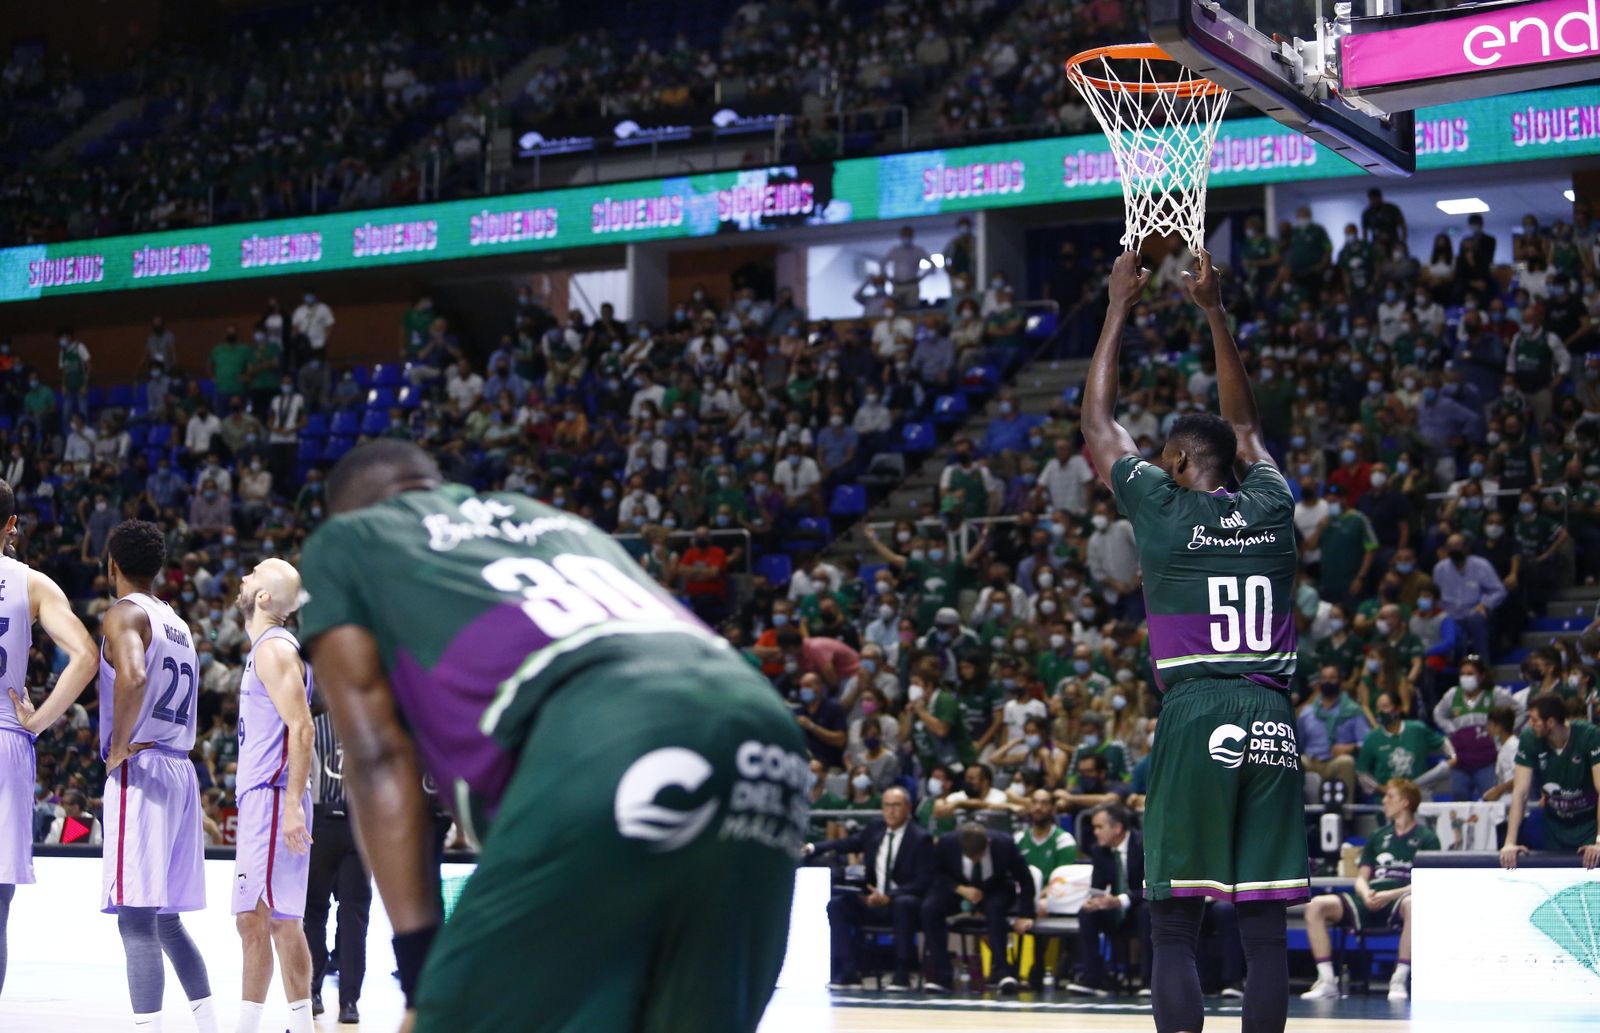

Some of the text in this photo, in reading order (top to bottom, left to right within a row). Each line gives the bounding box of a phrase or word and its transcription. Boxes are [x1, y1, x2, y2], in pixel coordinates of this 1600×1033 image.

[481, 553, 676, 638] 30
[1208, 575, 1274, 652] 50
[151, 656, 194, 726] 22
[1247, 751, 1299, 771] MÁLAGA
[1249, 738, 1299, 757] DEL SOL
